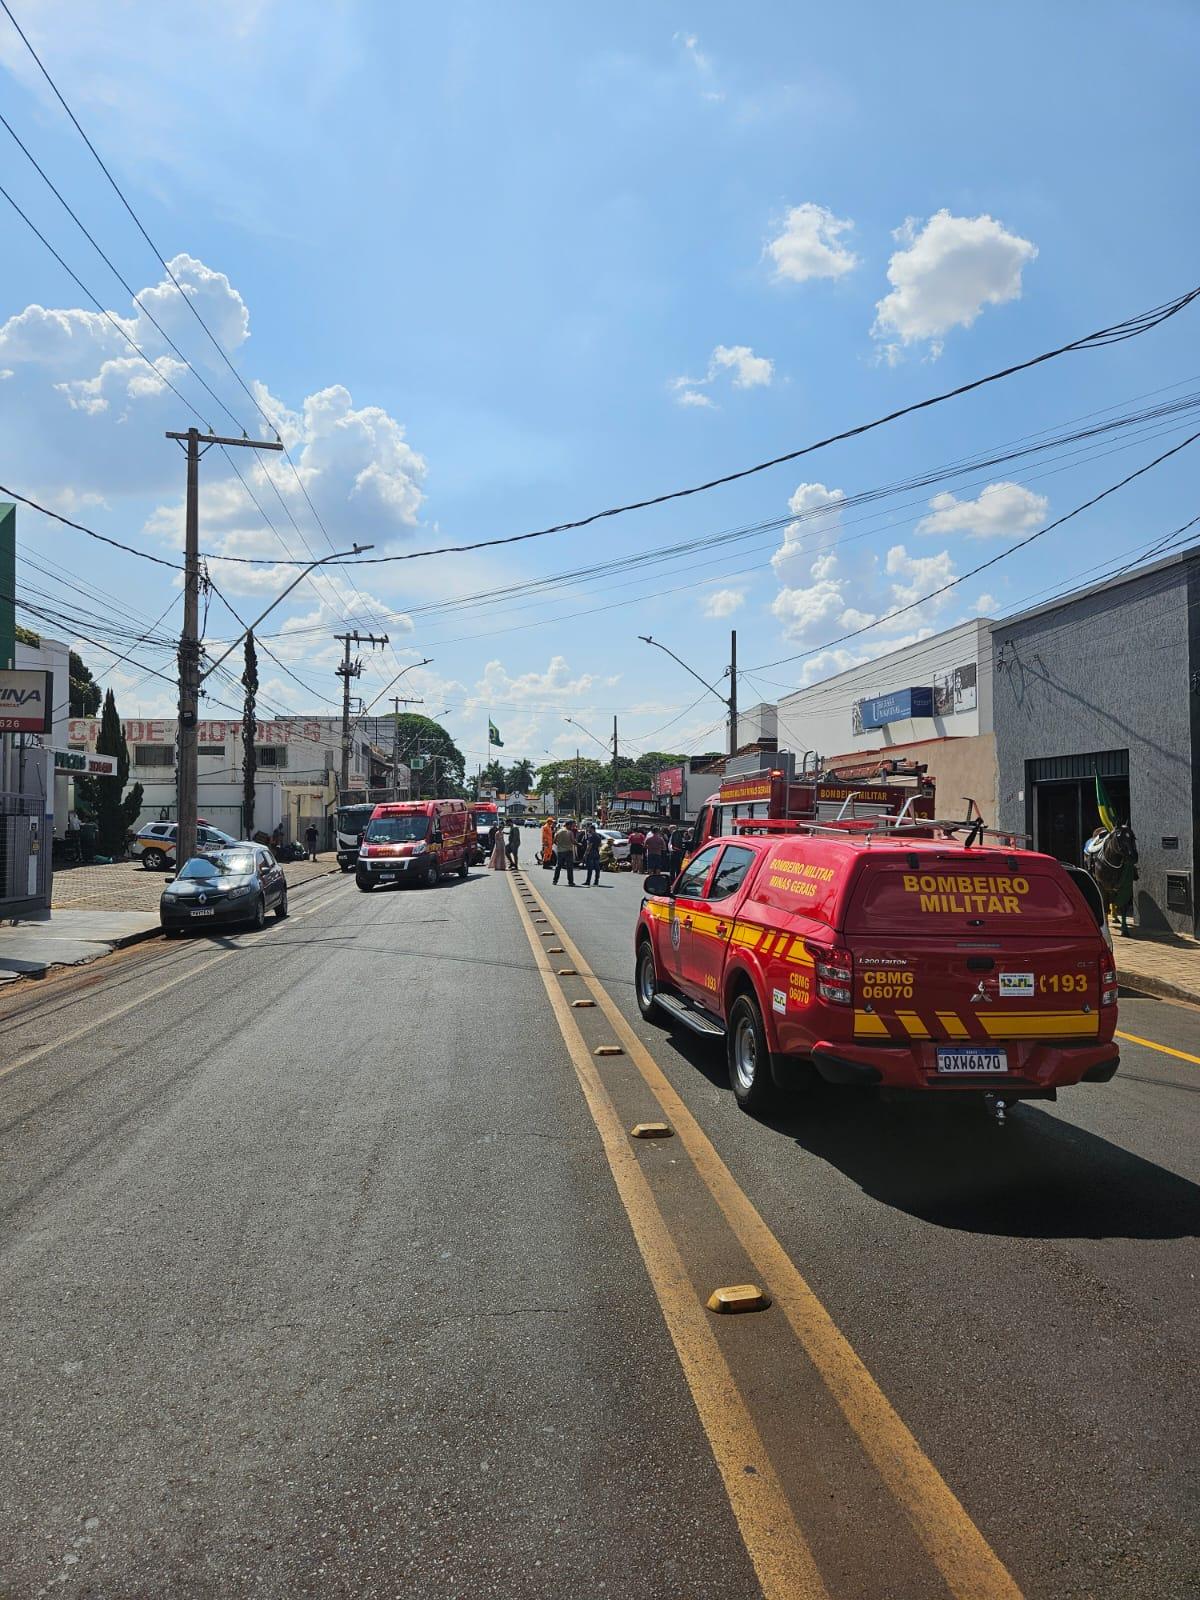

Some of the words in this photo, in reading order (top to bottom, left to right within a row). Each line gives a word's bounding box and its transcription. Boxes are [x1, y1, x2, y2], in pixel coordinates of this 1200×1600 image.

[0, 688, 41, 705] INA
[770, 859, 805, 875] BOMBEIRO
[802, 864, 834, 882] MILITAR
[770, 875, 791, 890] MINAS
[790, 880, 817, 897] GERAIS
[903, 875, 1030, 894] BOMBEIRO
[919, 895, 1022, 914] MILITAR
[789, 972, 810, 990] CBMG
[863, 971, 914, 985] CBMG
[1049, 974, 1088, 993] 193
[789, 986, 810, 1004] 06070
[862, 985, 913, 999] 06070
[943, 1055, 1001, 1070] QXW6A70
